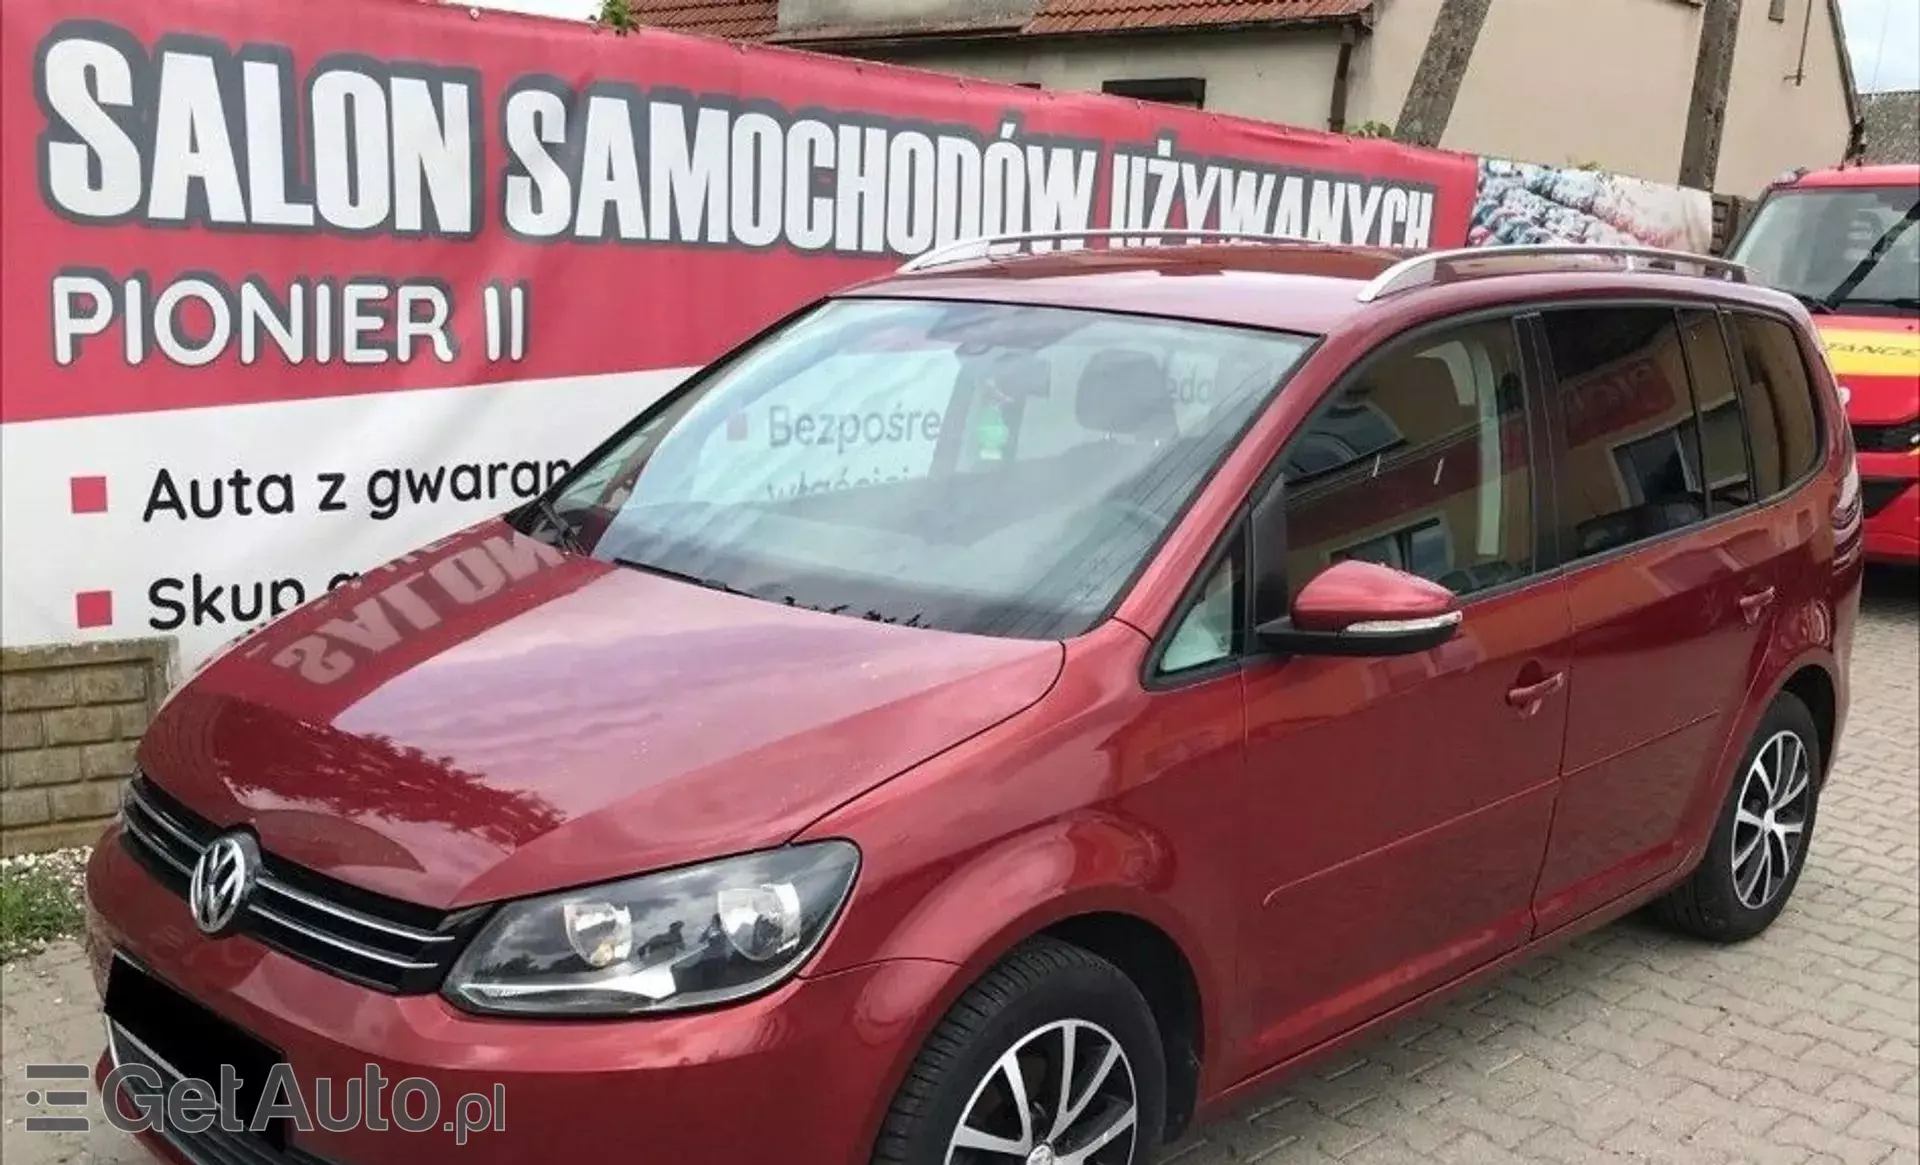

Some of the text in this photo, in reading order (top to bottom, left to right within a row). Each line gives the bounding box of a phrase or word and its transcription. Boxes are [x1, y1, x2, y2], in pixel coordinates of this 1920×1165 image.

[44, 38, 1434, 256] SALON SAMOCHODÓW UŻYWANYCH
[52, 275, 523, 366] PIONIER II
[768, 403, 942, 455] Bezpośre
[142, 467, 294, 522] Auta
[317, 471, 346, 511] z
[148, 573, 306, 630] Skup
